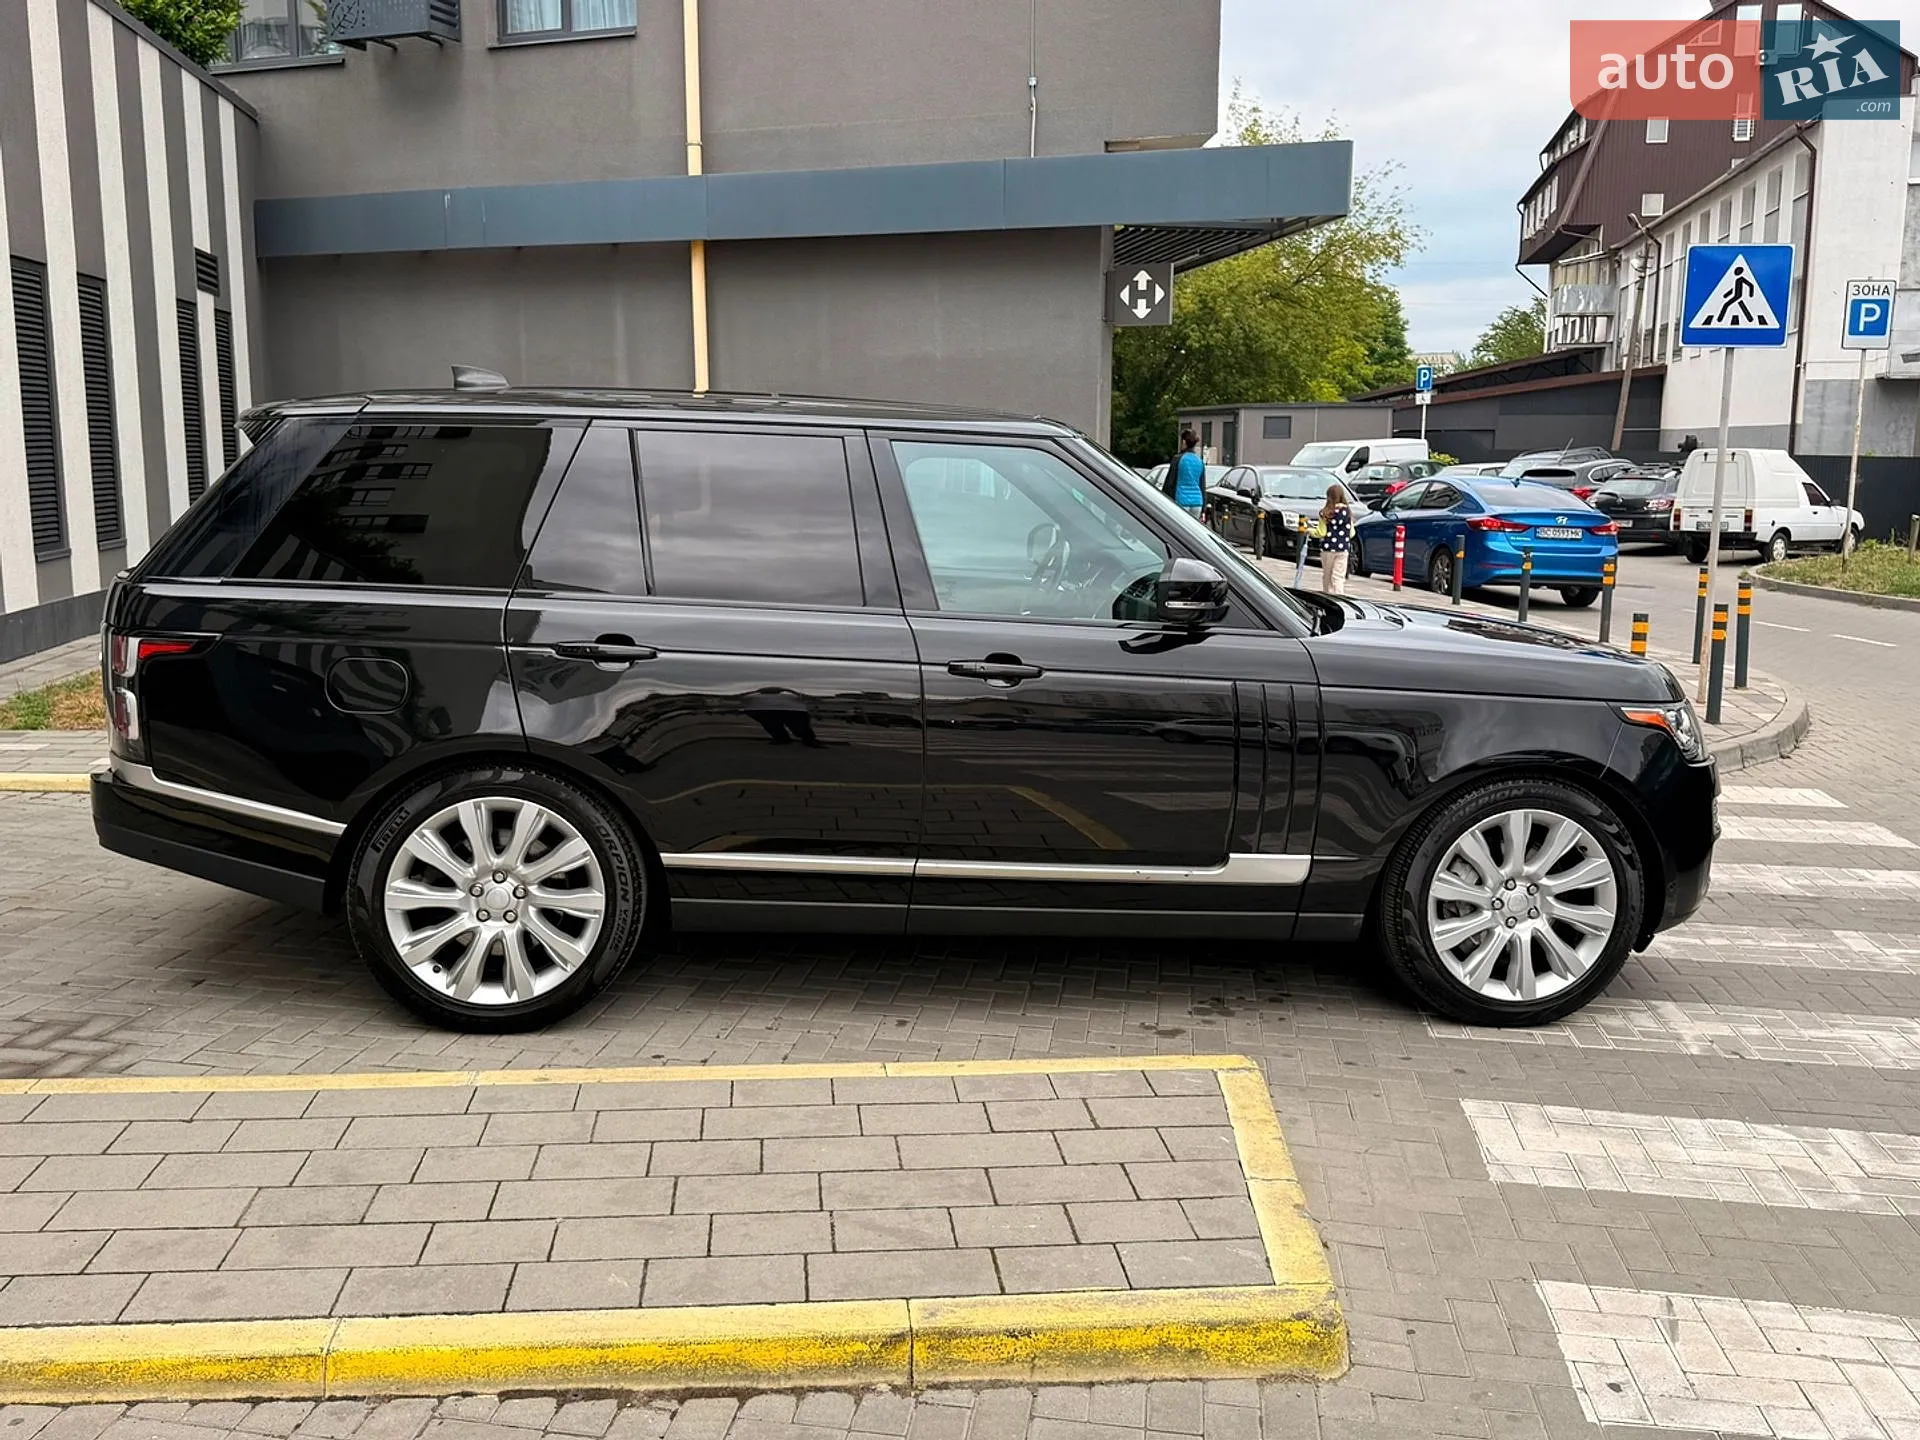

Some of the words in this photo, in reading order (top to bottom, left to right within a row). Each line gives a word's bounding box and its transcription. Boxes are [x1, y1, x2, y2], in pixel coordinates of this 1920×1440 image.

[1852, 284, 1891, 296] ЗОНА
[1858, 303, 1881, 332] P
[1420, 369, 1430, 387] P
